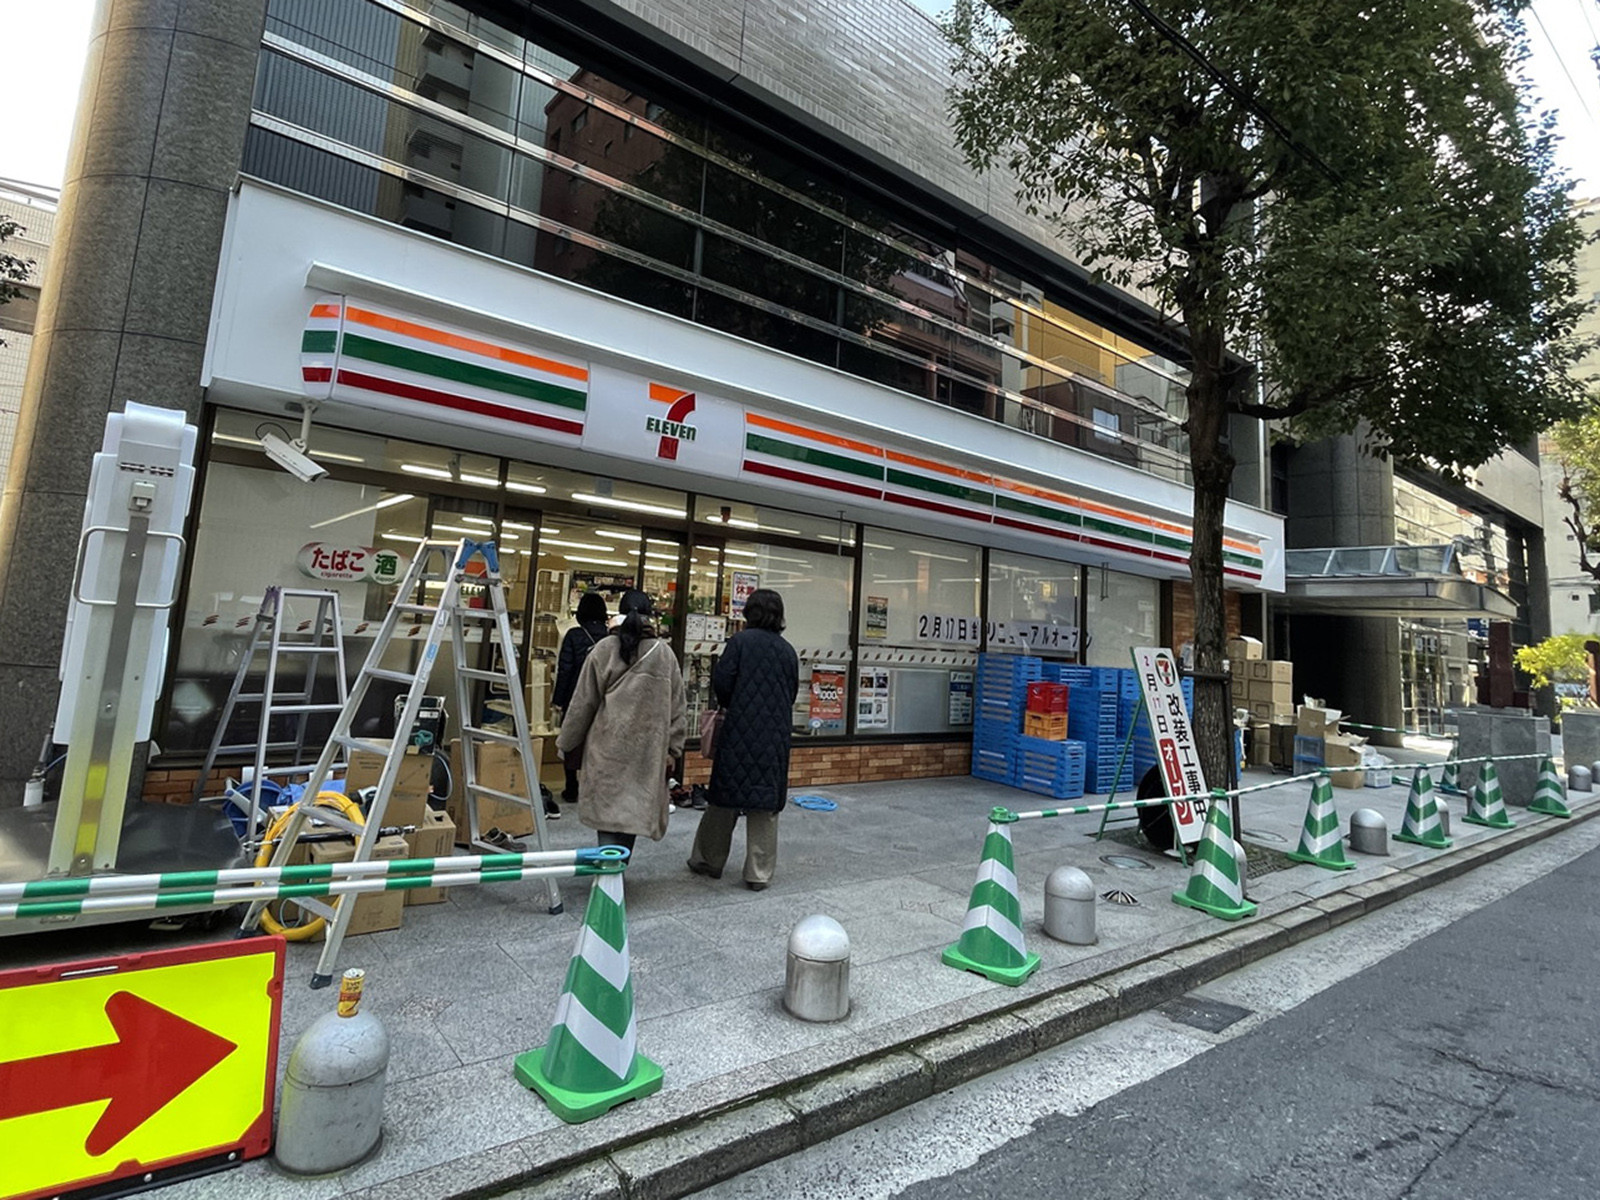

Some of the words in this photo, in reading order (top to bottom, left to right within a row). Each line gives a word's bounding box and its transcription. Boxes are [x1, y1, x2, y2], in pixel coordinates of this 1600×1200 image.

[649, 382, 696, 461] 7
[311, 547, 365, 572] たばこ
[374, 553, 398, 576] 酒
